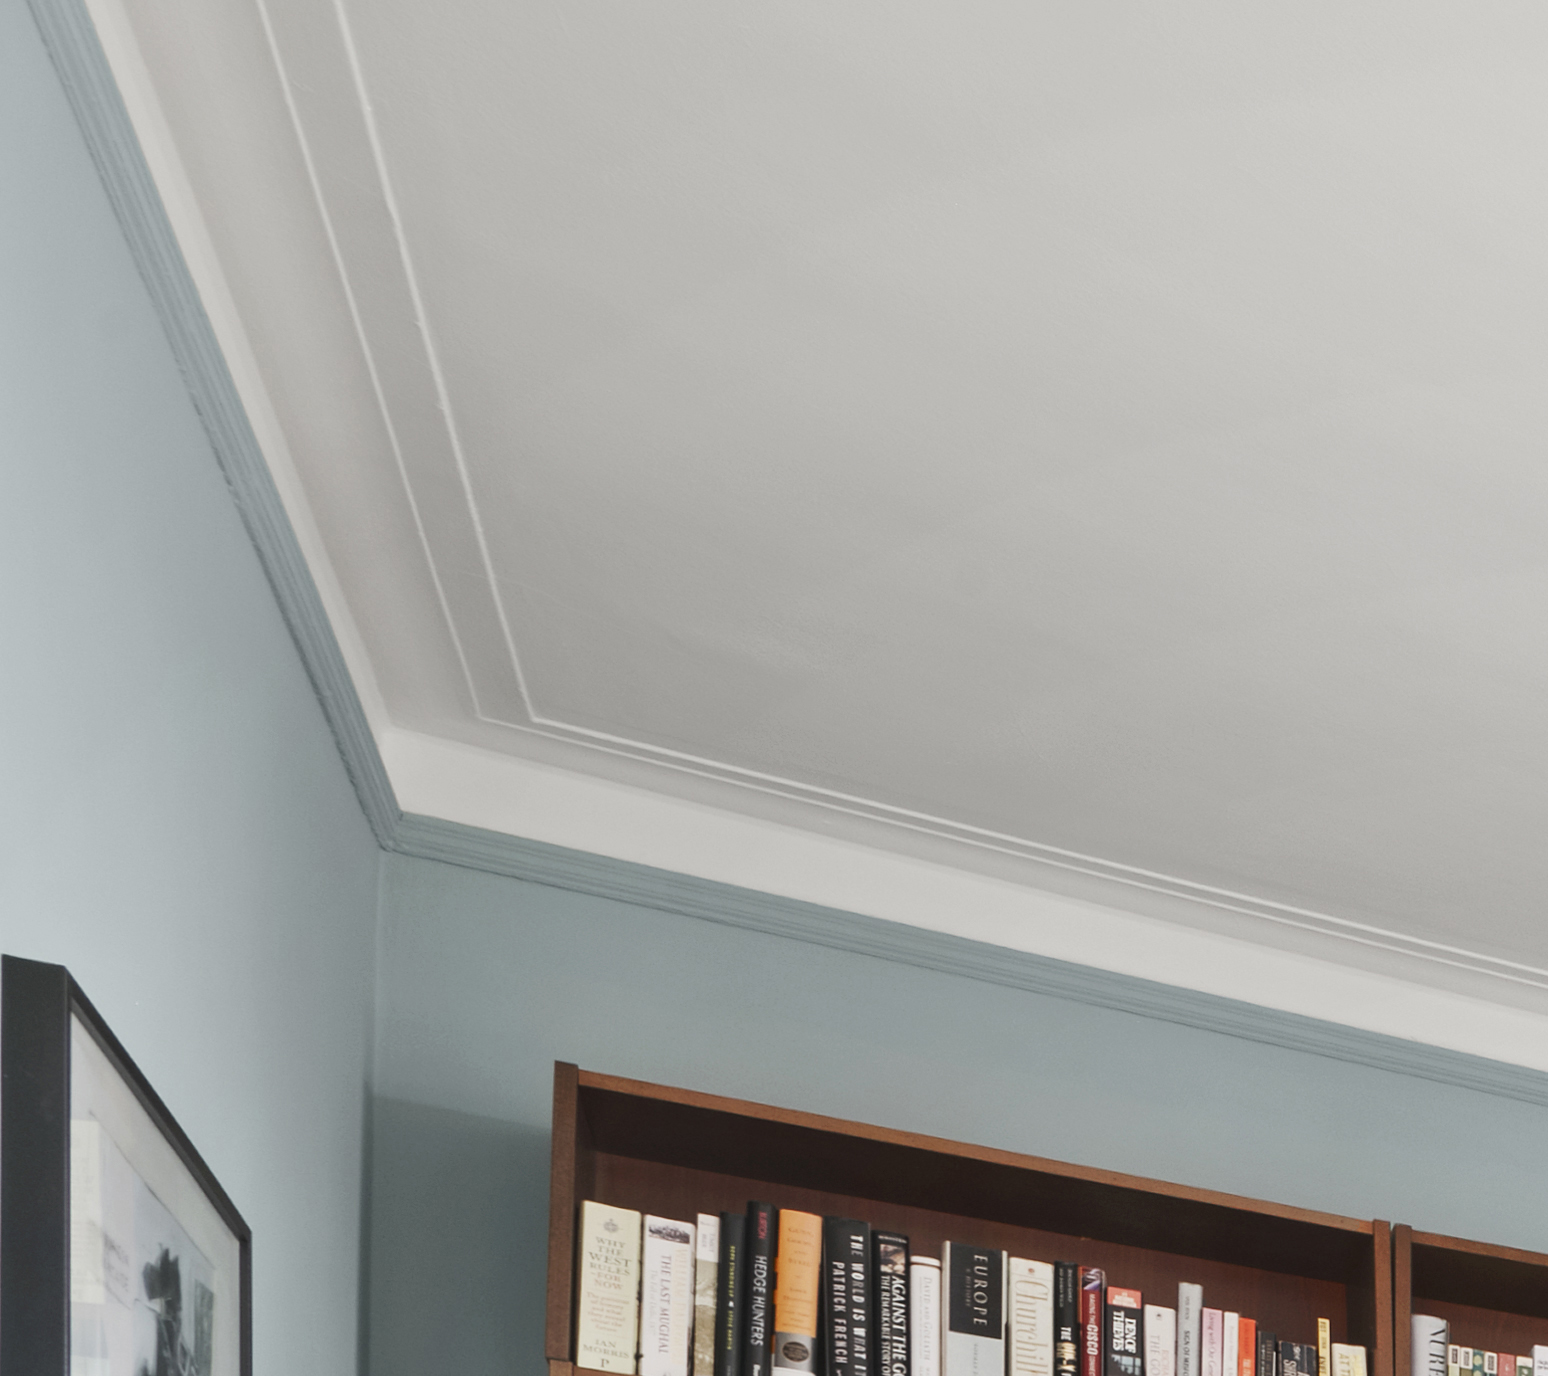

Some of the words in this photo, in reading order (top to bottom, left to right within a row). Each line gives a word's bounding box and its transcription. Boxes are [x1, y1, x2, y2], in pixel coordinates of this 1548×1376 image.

[595, 1236, 625, 1249] WHY
[598, 1245, 622, 1256] THE
[850, 1235, 863, 1257] THE
[588, 1251, 632, 1268] WEST
[589, 1262, 631, 1277] RULES
[661, 1254, 671, 1272] THE
[594, 1278, 624, 1290] NOW
[752, 1255, 768, 1294] HEDGE
[851, 1263, 865, 1303] WORLD
[881, 1276, 891, 1289] THE
[660, 1275, 671, 1304] LAST
[832, 1261, 846, 1313] PATRICK
[974, 1254, 988, 1326] EUROPE
[852, 1308, 865, 1321] IS
[881, 1290, 891, 1341] REMARKABLE
[892, 1276, 906, 1332] AGAINST
[658, 1305, 671, 1354] MUGHAL
[750, 1295, 767, 1347] HUNTERS
[1015, 1279, 1049, 1375] Churchill
[1113, 1311, 1124, 1351] THIEVES
[1124, 1317, 1136, 1336] DEN
[595, 1338, 617, 1348] IAN
[834, 1319, 848, 1364] FRENCH
[853, 1328, 866, 1360] WHAT
[1060, 1327, 1071, 1341] THE
[1087, 1324, 1099, 1355] CISCO
[1150, 1334, 1160, 1352] THE
[583, 1344, 630, 1359] MORRIS
[881, 1343, 891, 1366] STORY
[892, 1334, 906, 1360] THE
